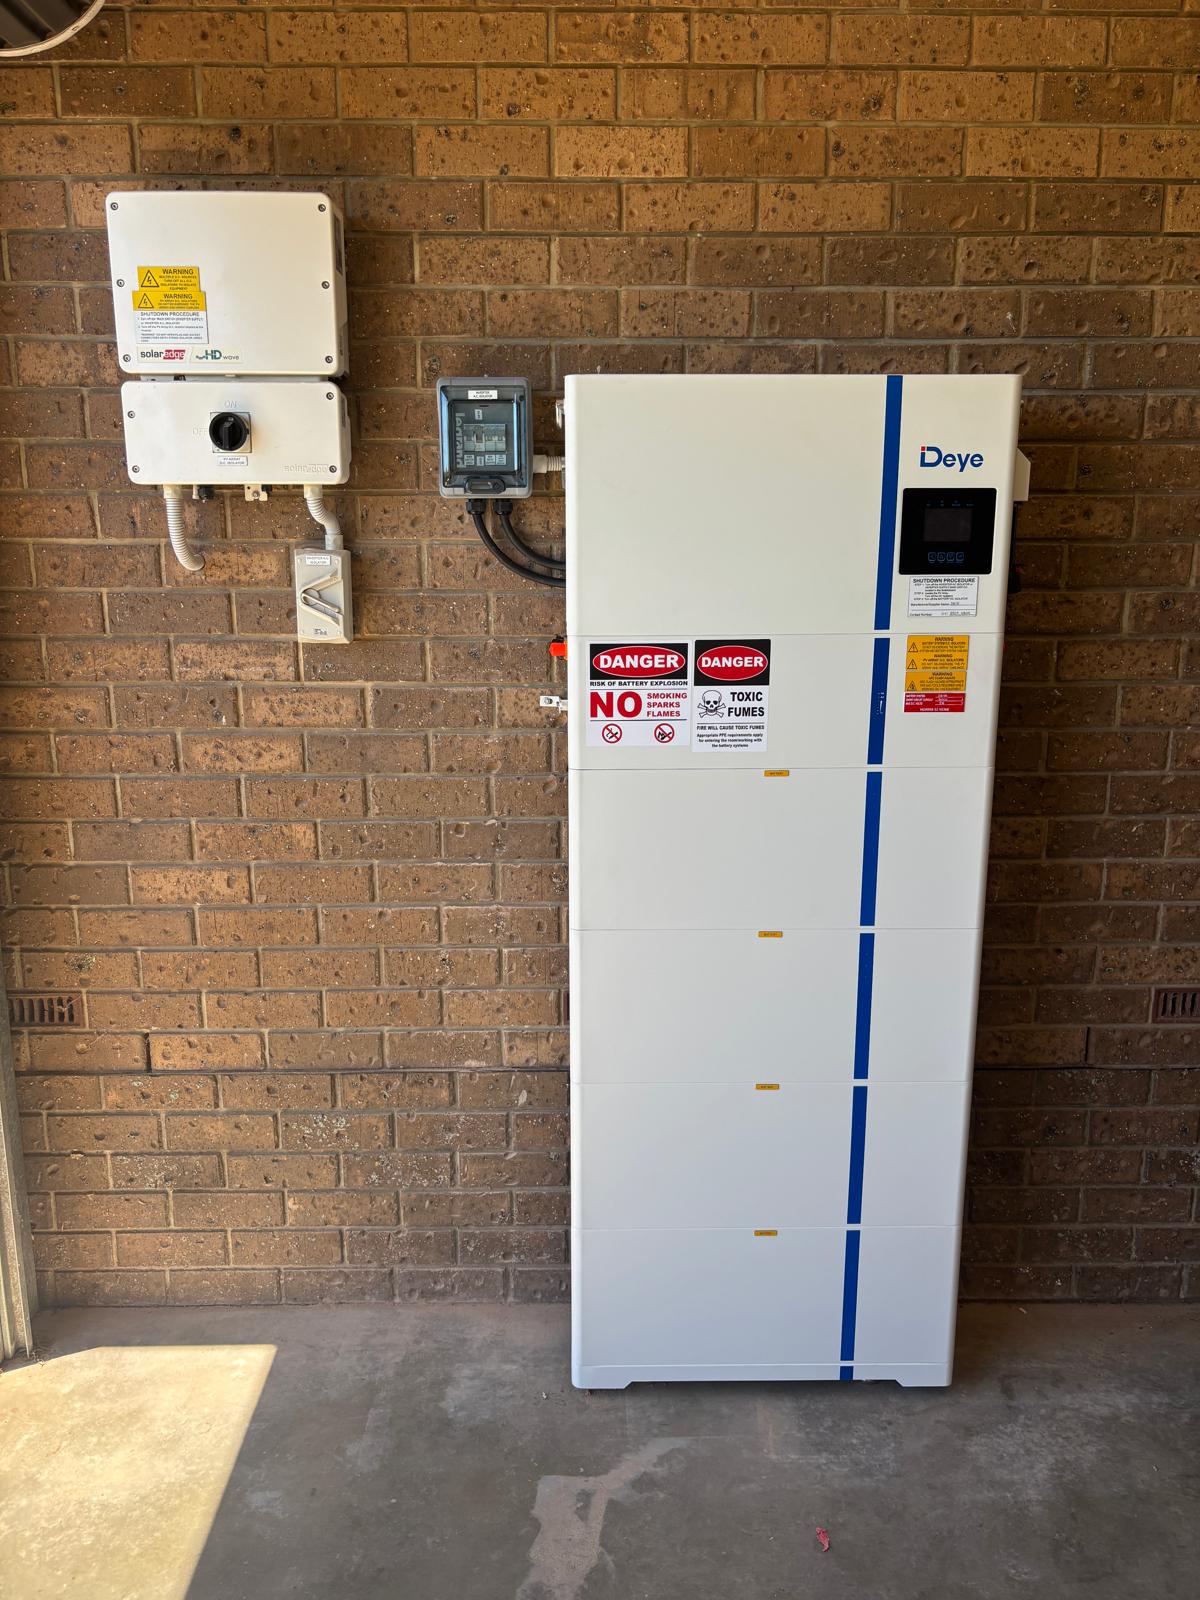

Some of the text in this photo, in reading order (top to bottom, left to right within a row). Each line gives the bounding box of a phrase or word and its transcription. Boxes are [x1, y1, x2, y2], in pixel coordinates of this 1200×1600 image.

[140, 349, 185, 360] solaredge
[205, 350, 222, 360] HD
[224, 401, 237, 409] ON
[920, 446, 984, 472] Deye
[600, 655, 679, 668] DANGER
[701, 656, 763, 668] DANGER
[730, 692, 763, 701] TOXIC
[590, 691, 642, 718] NO
[728, 707, 764, 717] FUMES
